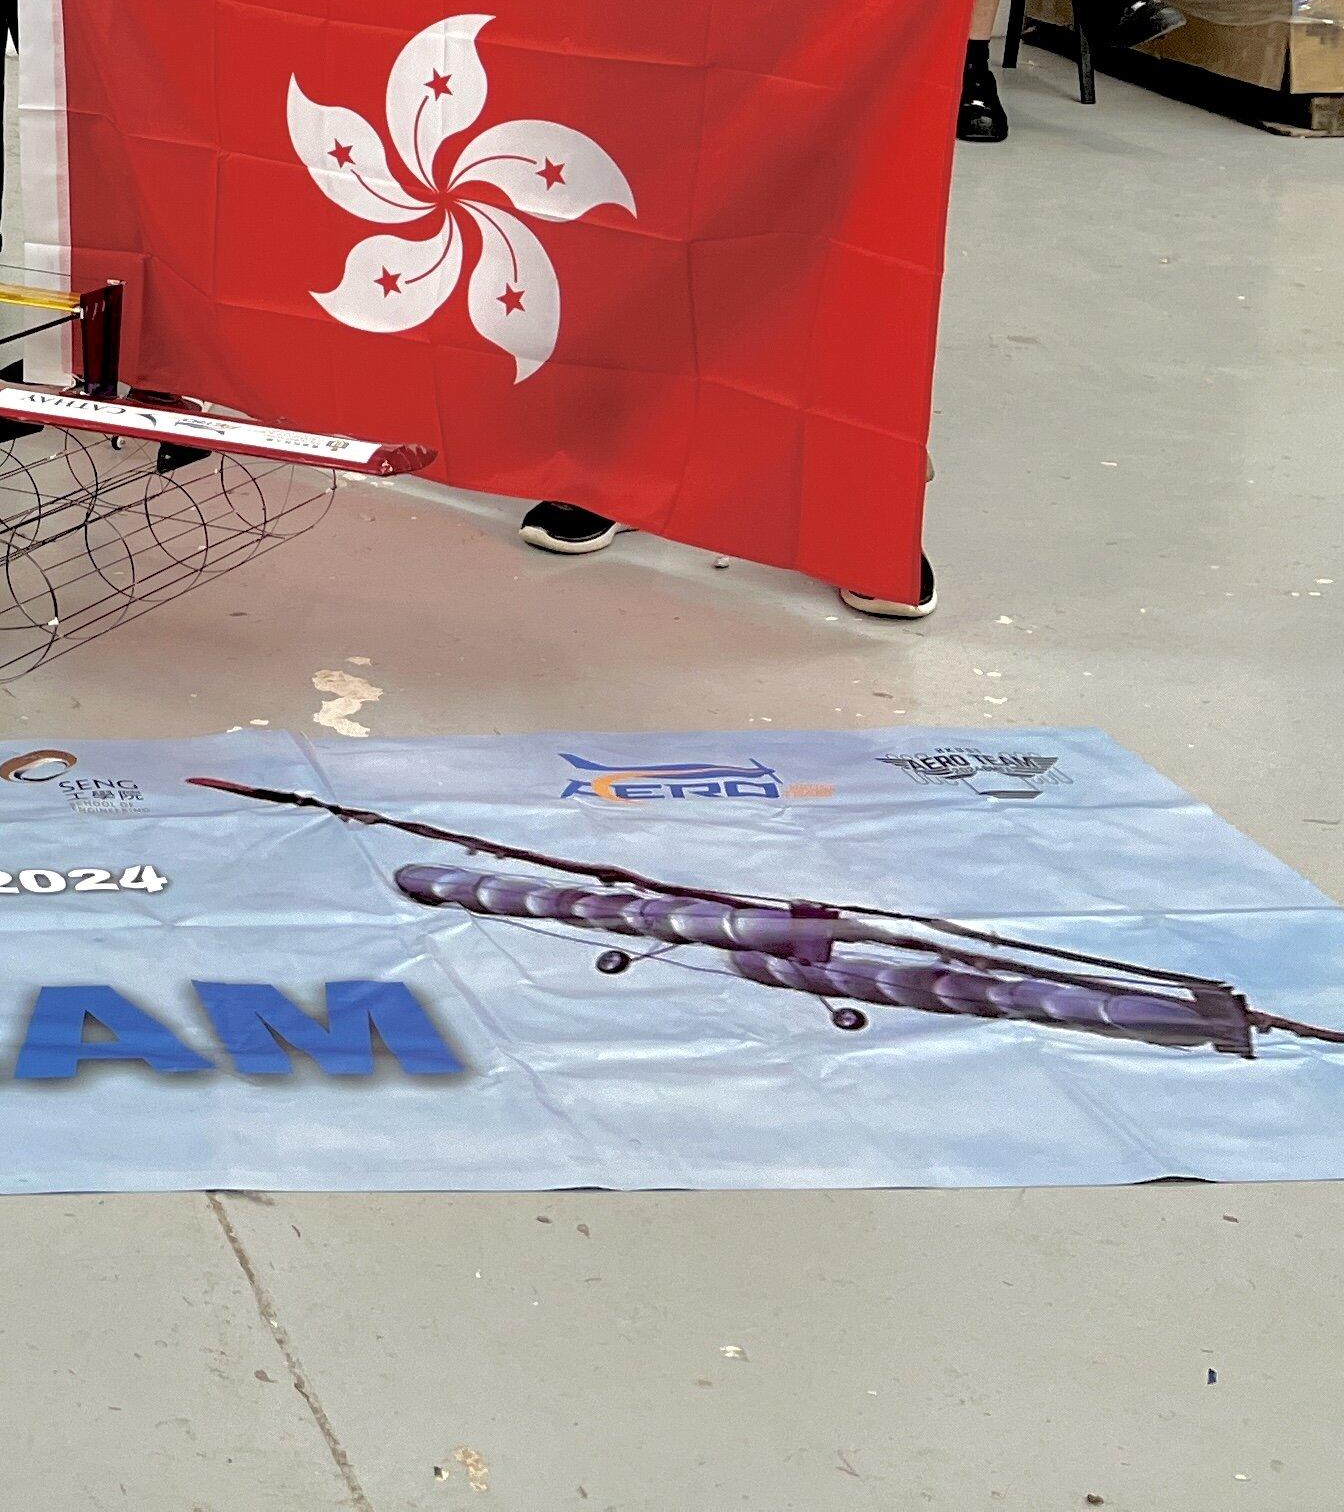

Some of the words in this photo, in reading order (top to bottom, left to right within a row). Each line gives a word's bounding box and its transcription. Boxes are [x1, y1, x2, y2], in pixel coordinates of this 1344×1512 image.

[907, 754, 970, 770] AERO
[972, 753, 1036, 769] TEAM
[59, 779, 138, 793] SENG
[561, 778, 780, 800] AERO
